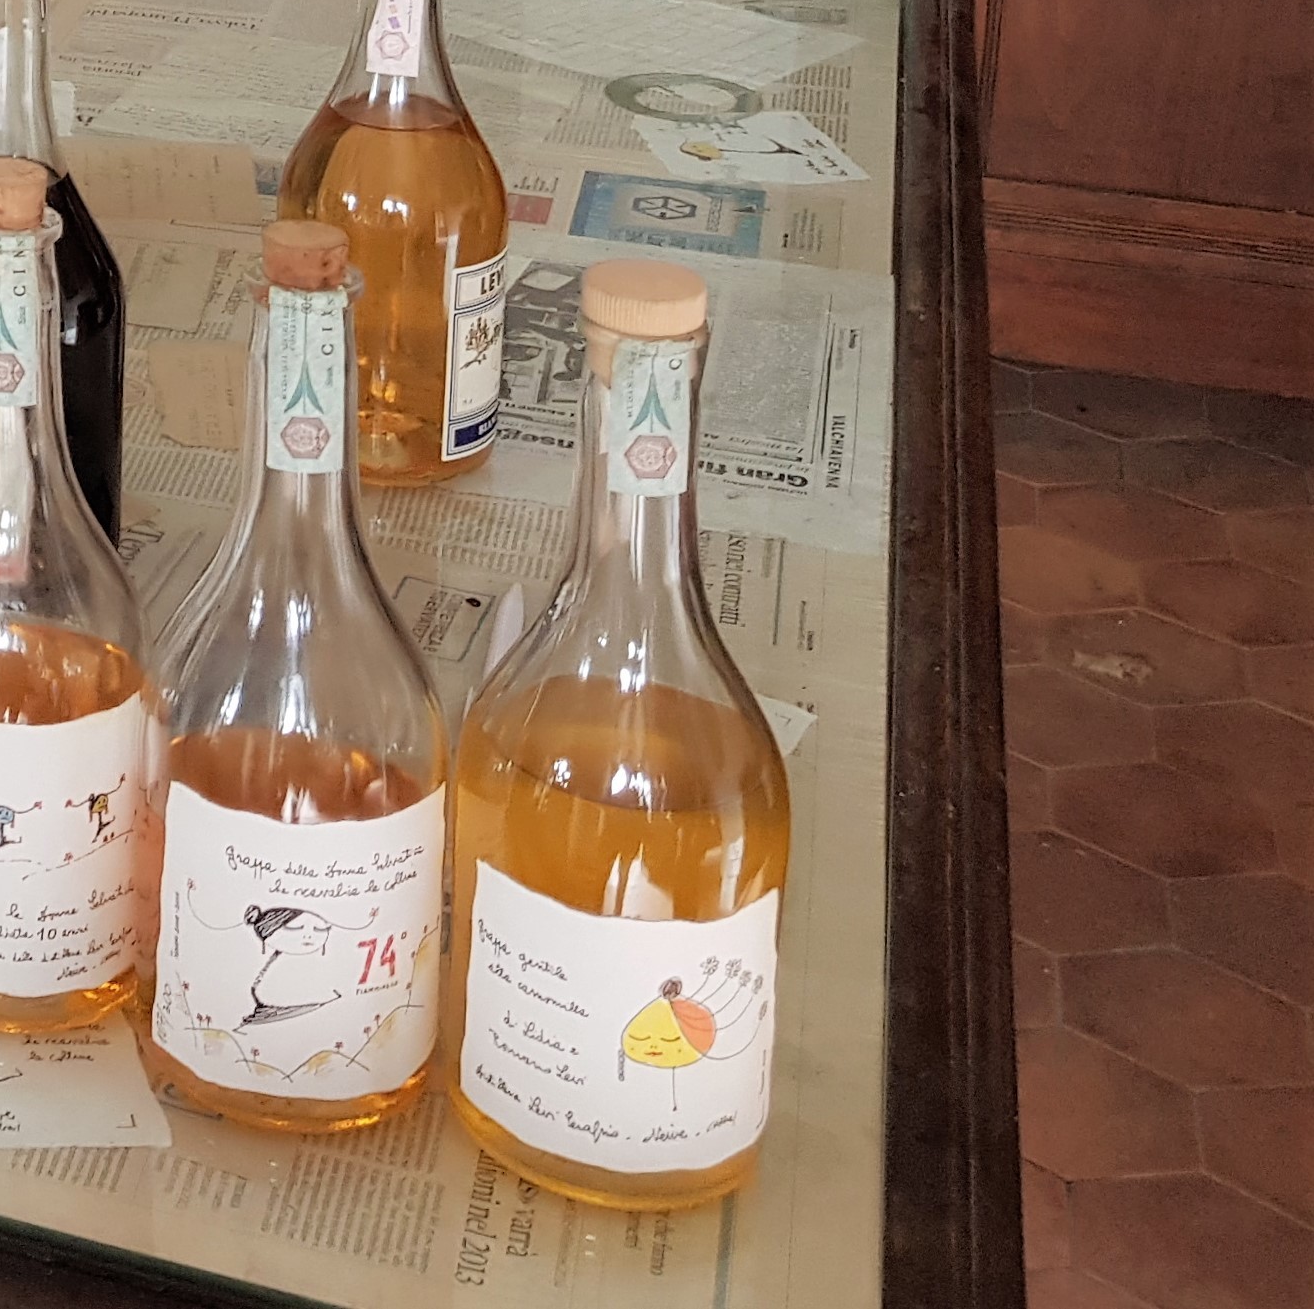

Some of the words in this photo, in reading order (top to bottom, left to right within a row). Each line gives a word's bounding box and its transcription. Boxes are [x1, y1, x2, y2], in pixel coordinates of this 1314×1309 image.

[825, 415, 846, 489] VALCHIAVENNA
[736, 465, 809, 488] Gran
[36, 925, 57, 941] 10
[454, 1237, 490, 1285] 2013
